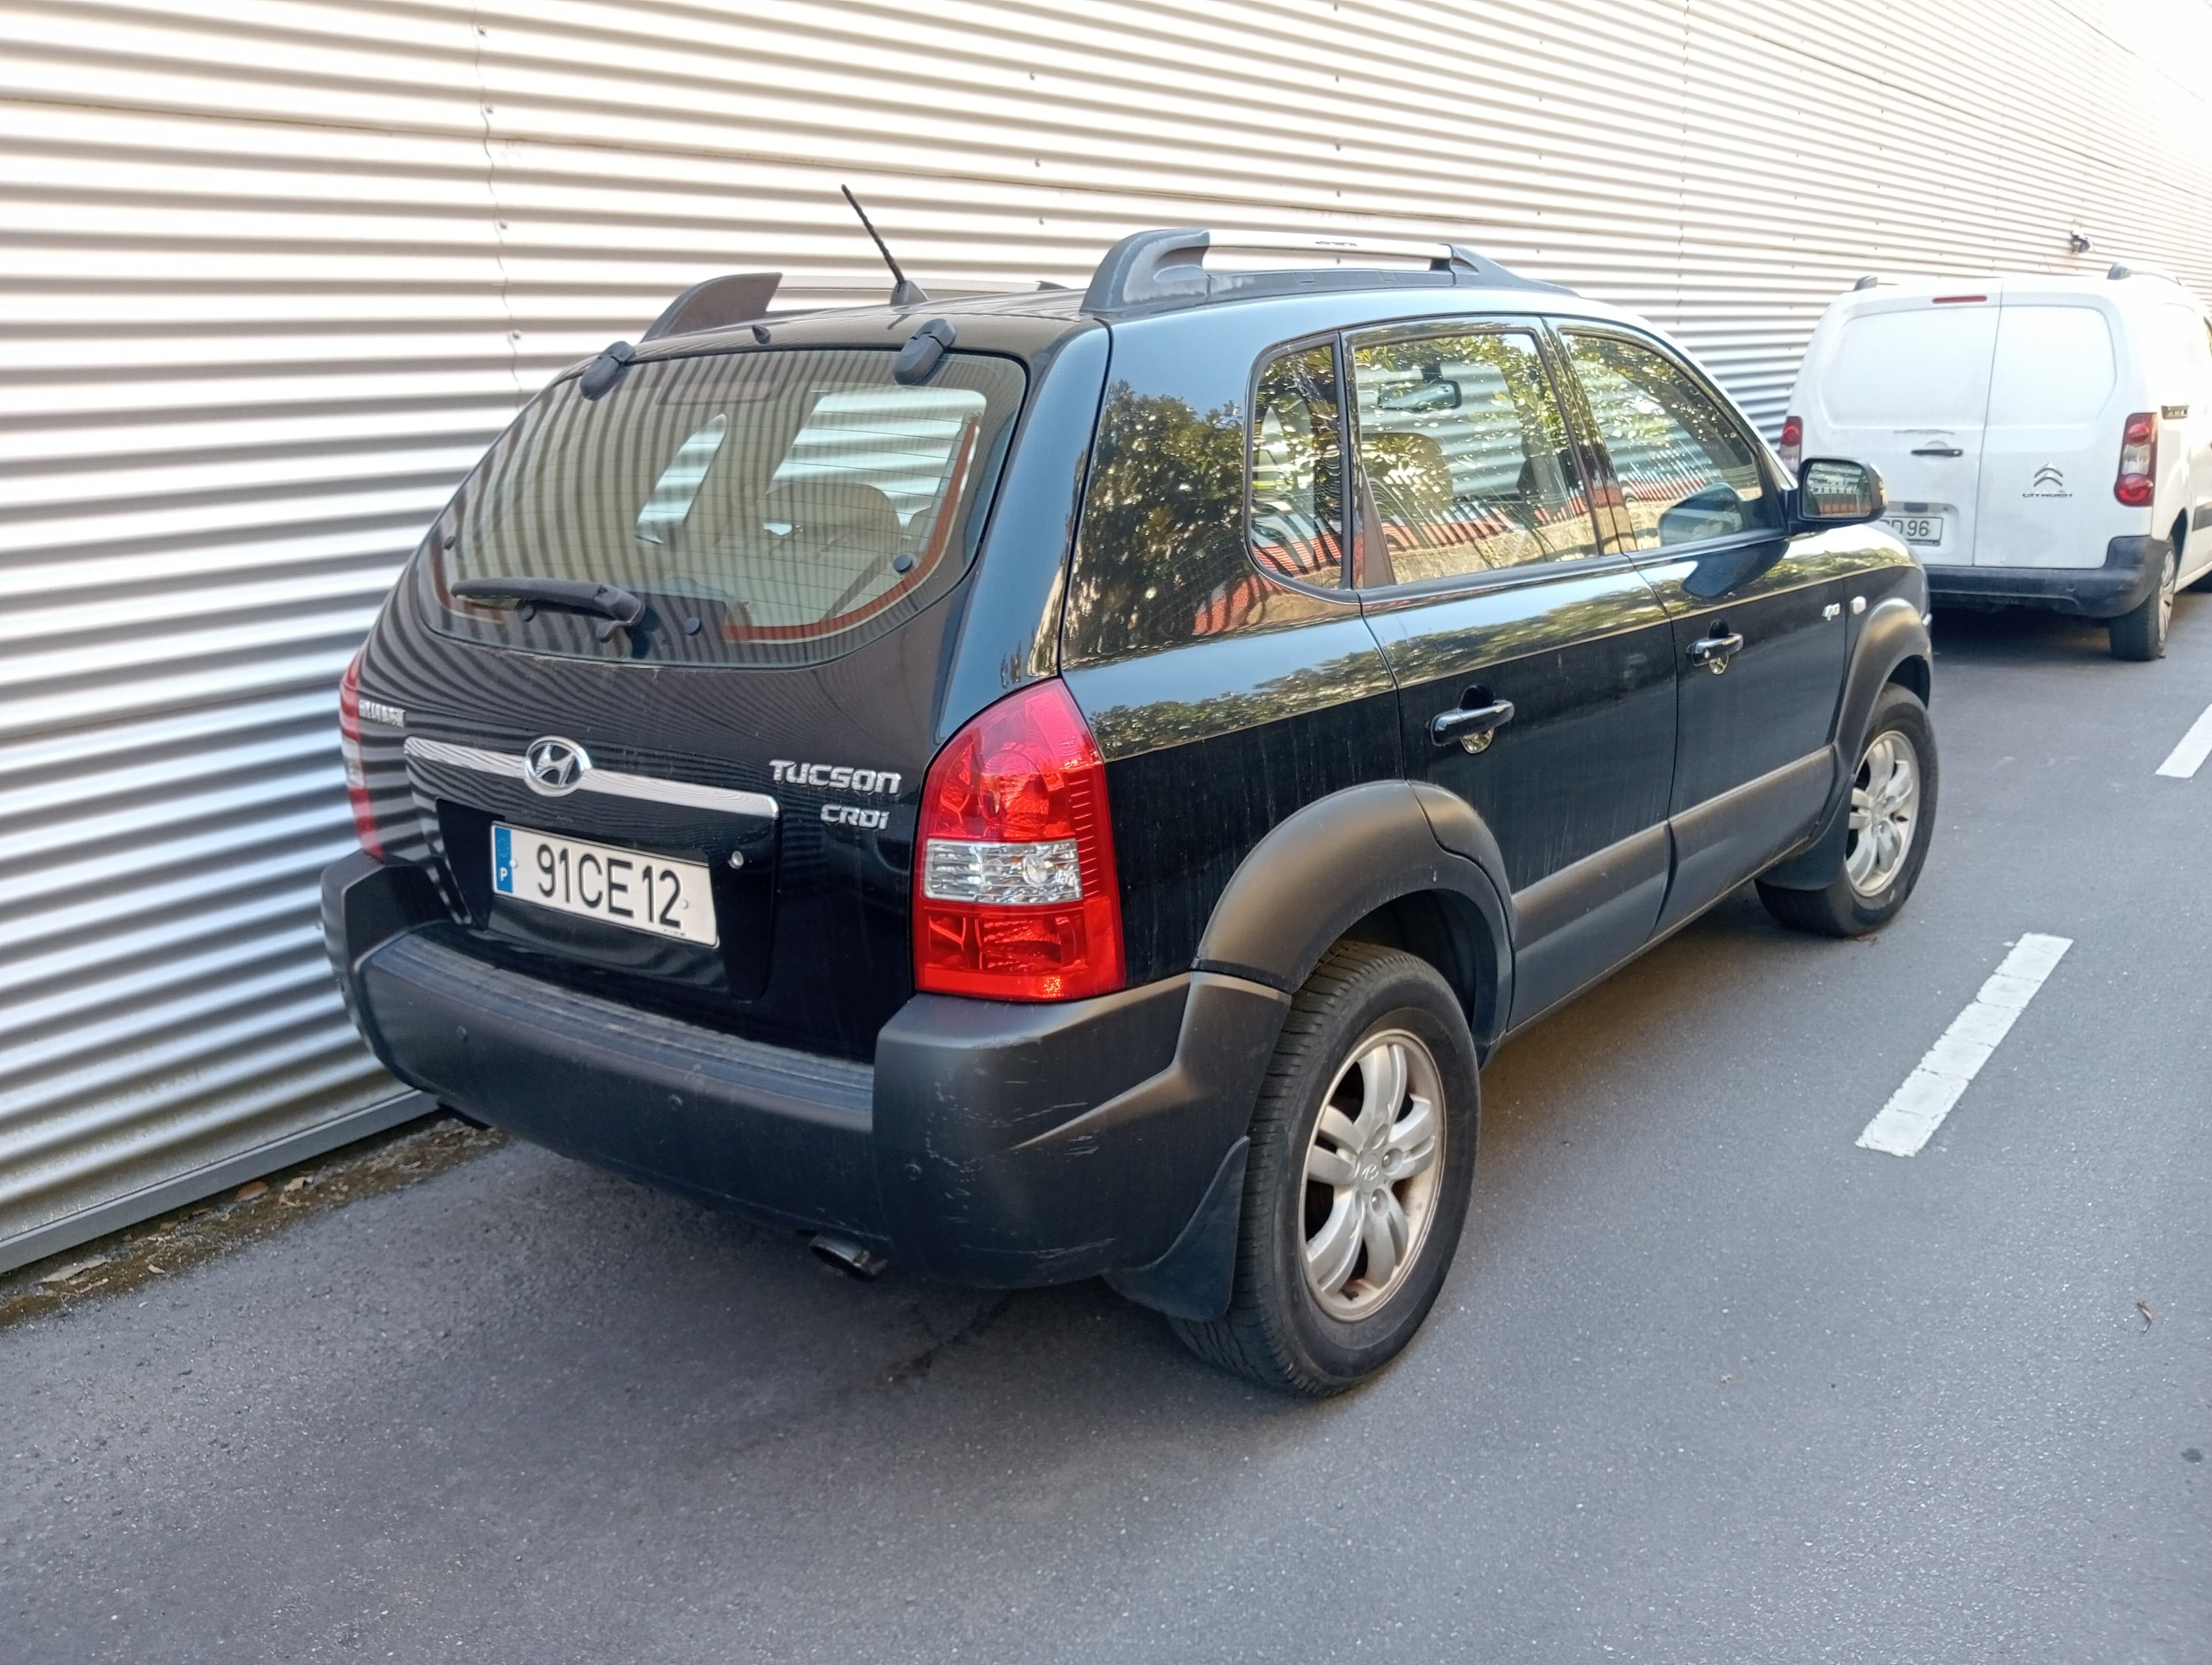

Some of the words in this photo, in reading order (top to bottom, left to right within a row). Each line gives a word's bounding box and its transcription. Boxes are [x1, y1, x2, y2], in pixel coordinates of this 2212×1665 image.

[769, 759, 902, 794] TUCSON
[500, 867, 508, 882] P
[537, 844, 681, 928] 91CE12
